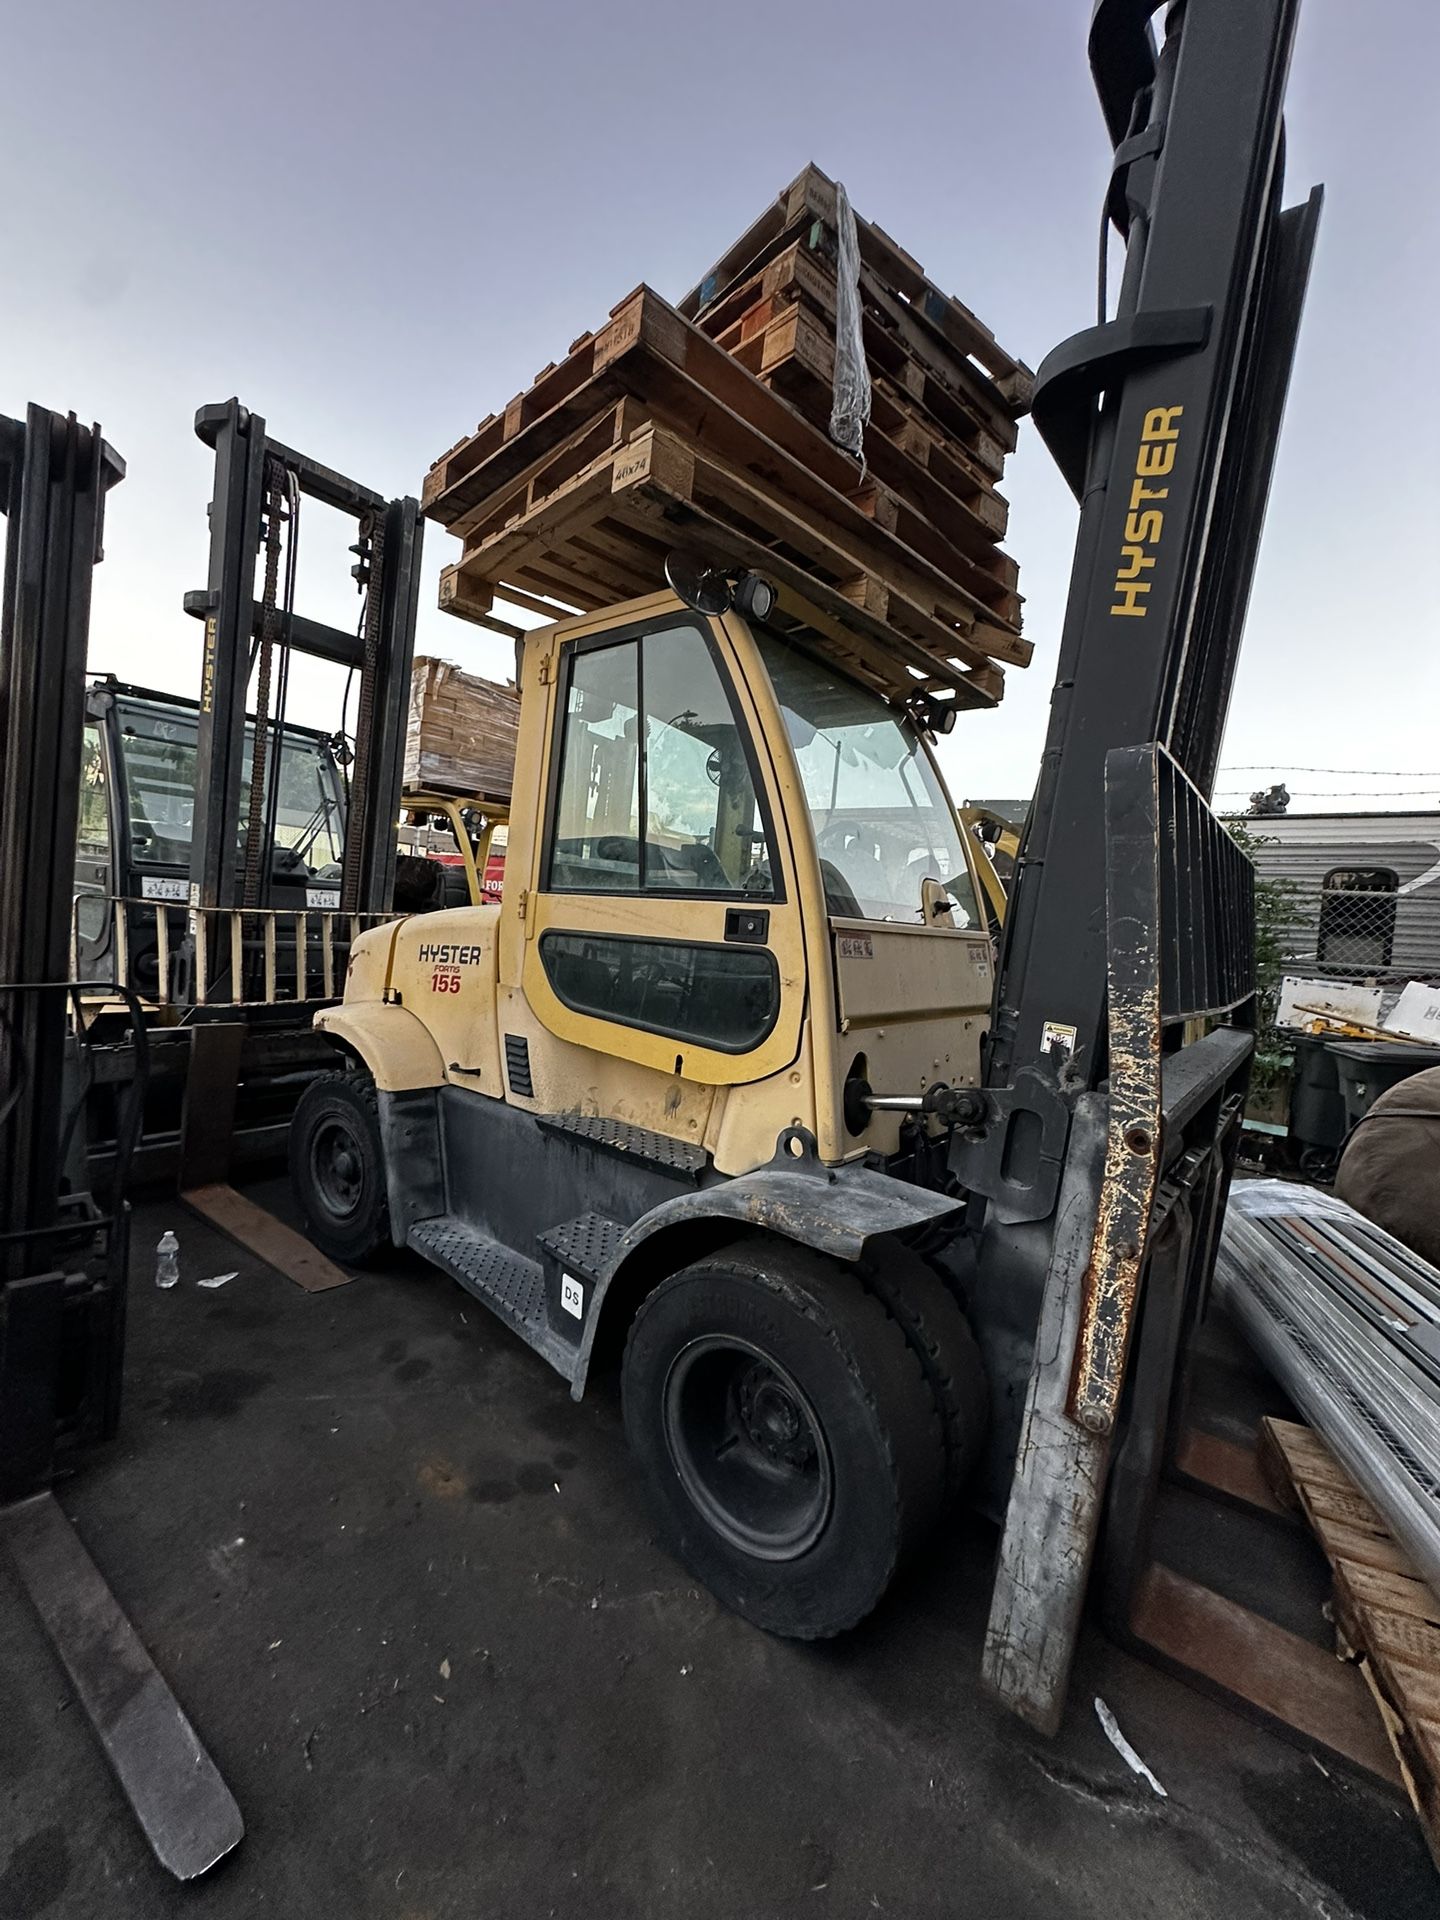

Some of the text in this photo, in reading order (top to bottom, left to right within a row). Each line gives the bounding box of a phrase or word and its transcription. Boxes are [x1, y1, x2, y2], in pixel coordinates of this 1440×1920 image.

[1110, 406, 1184, 616] HYSTER
[203, 617, 216, 713] HYSTER
[418, 944, 482, 966] HYSTER
[433, 964, 461, 974] FORTIS
[432, 973, 461, 994] 155
[565, 1286, 579, 1306] DS
